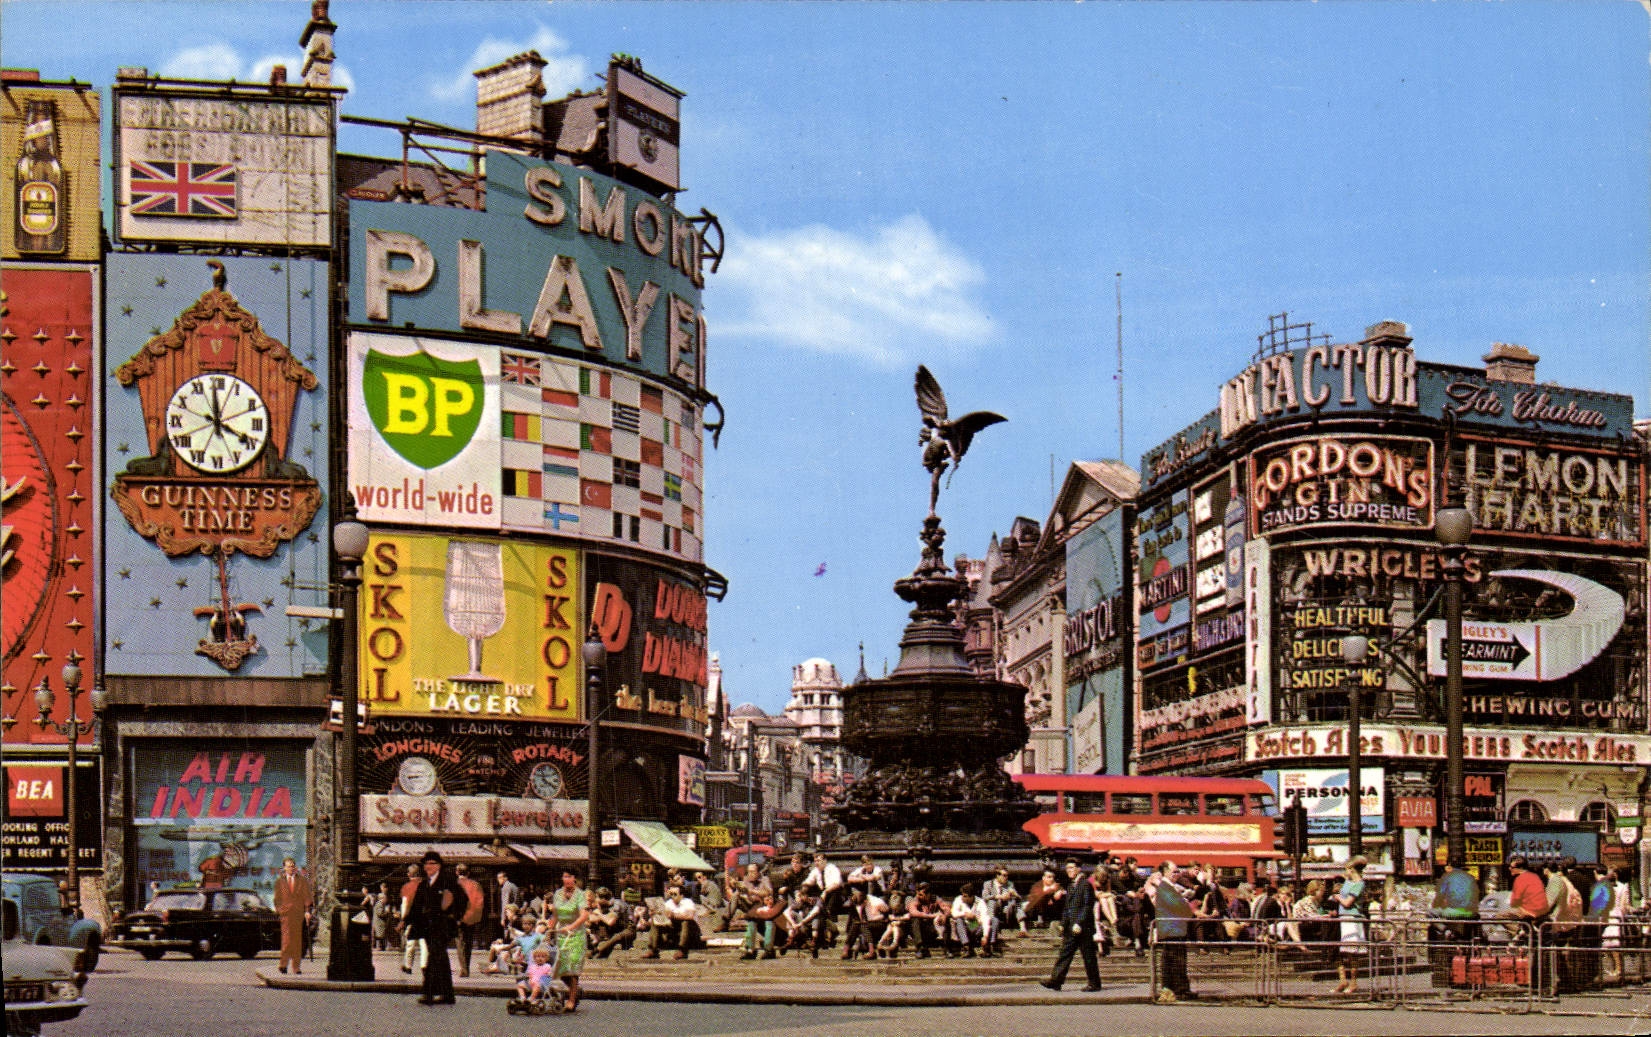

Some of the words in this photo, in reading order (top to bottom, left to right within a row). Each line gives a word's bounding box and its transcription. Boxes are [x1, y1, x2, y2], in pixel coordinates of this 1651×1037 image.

[365, 228, 706, 390] PLAYE
[1262, 343, 1420, 416] FACTOR
[382, 371, 475, 437] BP
[1512, 390, 1608, 427] Charm
[1465, 443, 1629, 499] LEMON
[141, 485, 293, 508] GUINNESS
[355, 478, 493, 515] world-wide
[1295, 477, 1373, 507] GIN
[179, 509, 254, 532] TIME
[1261, 503, 1322, 528] STANDS
[1327, 502, 1418, 523] SUPREME
[1139, 566, 1184, 609] MARTINI
[368, 541, 404, 702] SKOL
[1063, 598, 1117, 658] BRISTOL
[1294, 607, 1388, 628] HEALTHFUL
[541, 555, 572, 712] SKOL
[1463, 625, 1508, 639] IGLEY'S
[1292, 637, 1380, 659] DELICIS
[1442, 642, 1519, 659] EARMINT
[413, 678, 446, 693] THE
[453, 681, 500, 695] LIGHT
[504, 683, 536, 698] DRY
[1291, 668, 1383, 689] SATISFNG
[428, 692, 523, 714] LAGER
[1581, 700, 1635, 720] GUM
[451, 721, 513, 737] LEADING
[373, 738, 463, 765] LONGINES
[511, 742, 585, 767] ROTARY
[1254, 729, 1317, 759] Scotch
[1397, 728, 1511, 758] YOUERS
[1521, 733, 1589, 760] Scotch
[1593, 736, 1637, 762] Ales
[180, 751, 267, 784] AIR
[16, 779, 54, 800] BEA
[1463, 775, 1496, 797] PAL
[149, 785, 294, 819] INDIA
[1400, 800, 1434, 818] AVIA
[2, 822, 38, 832] OOKING
[44, 822, 70, 832] OFFIC
[49, 835, 70, 845] HAL
